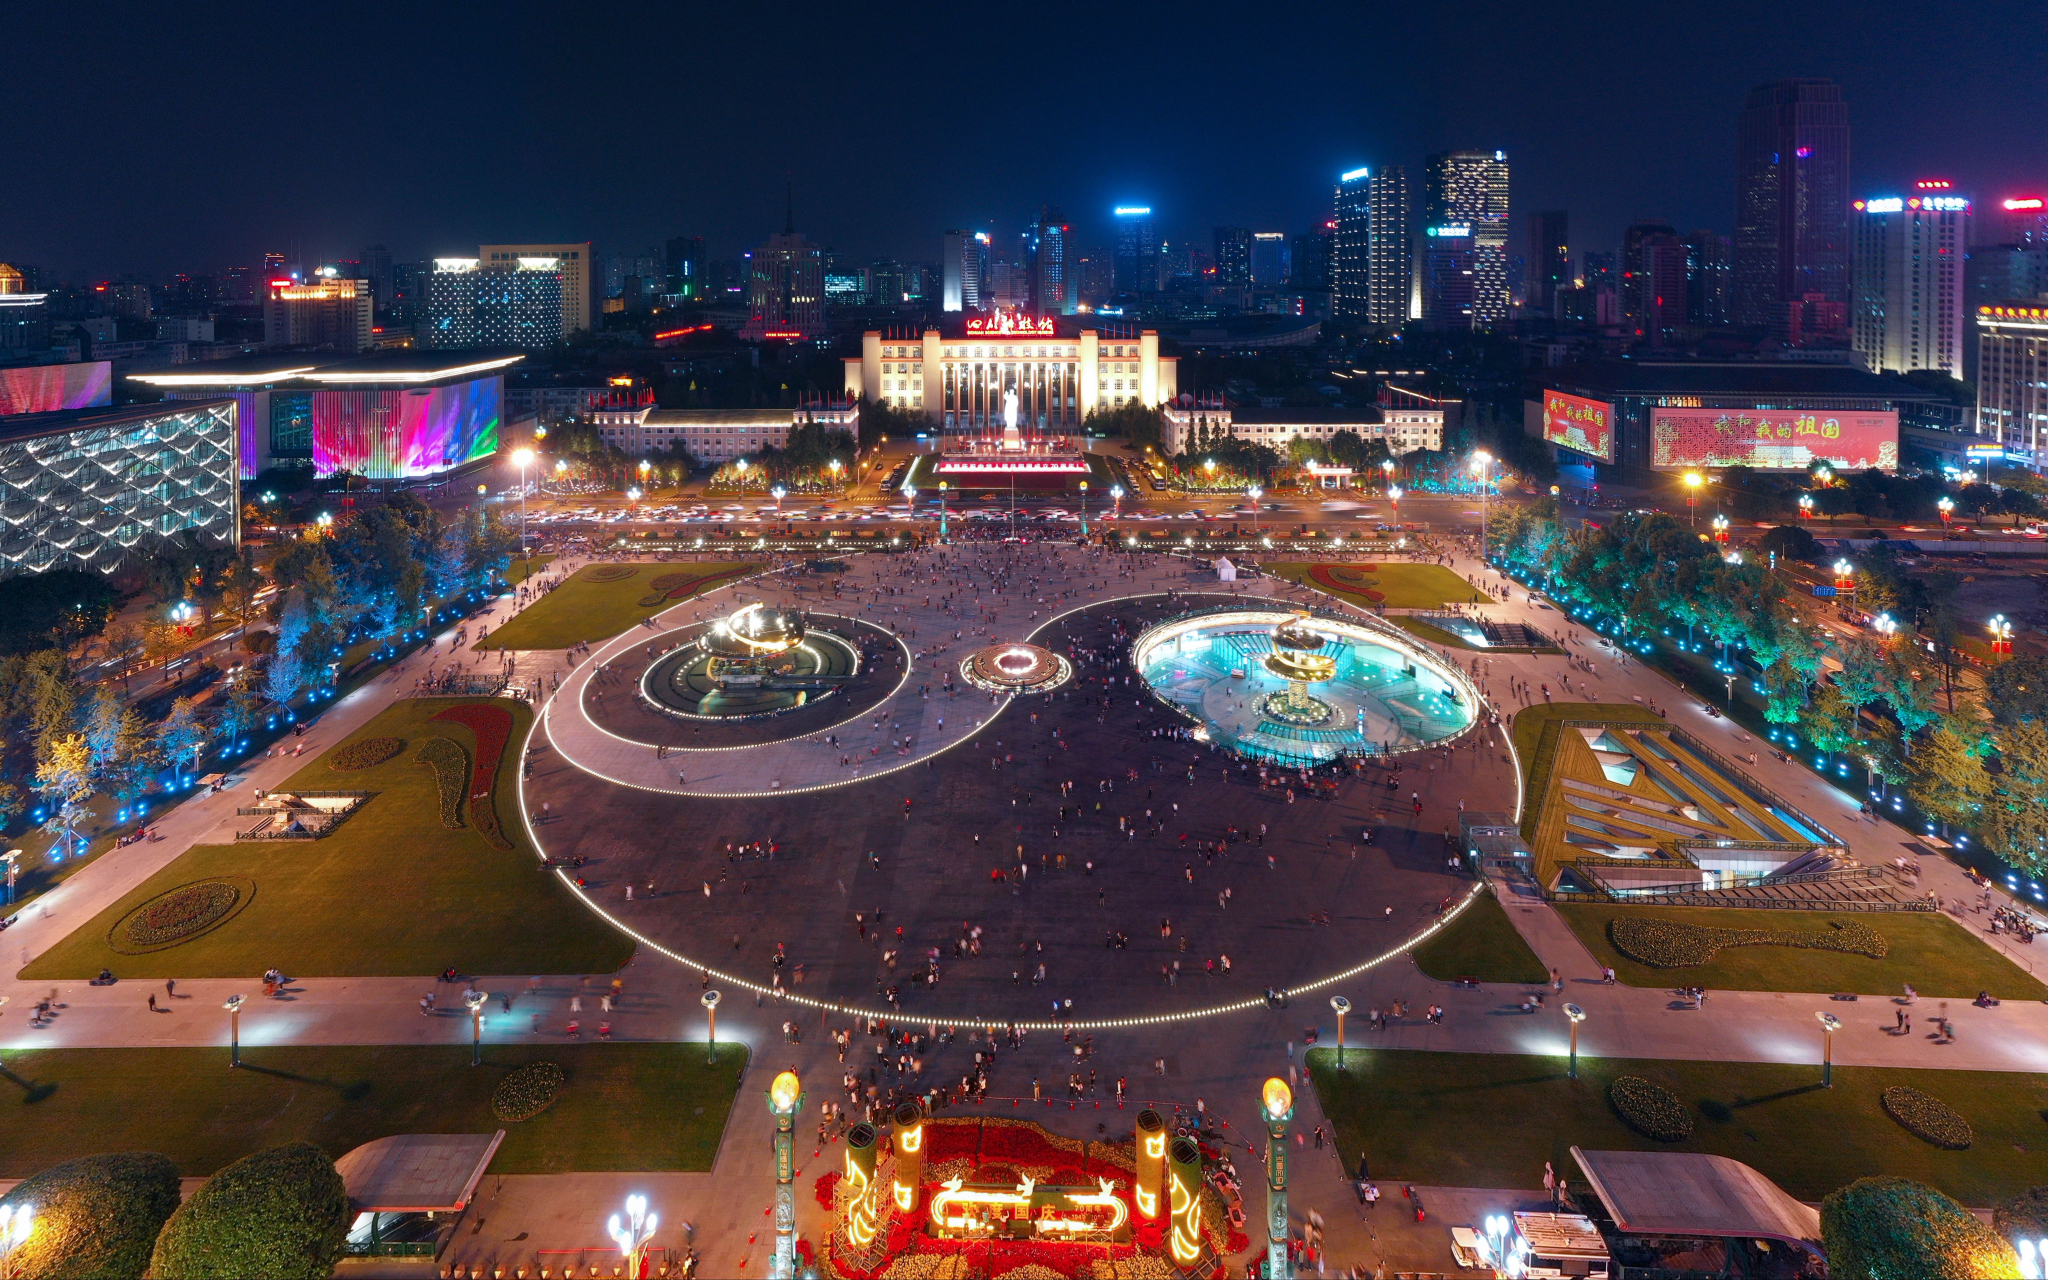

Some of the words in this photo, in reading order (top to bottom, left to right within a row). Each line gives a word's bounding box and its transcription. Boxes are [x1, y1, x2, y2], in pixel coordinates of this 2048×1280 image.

[1714, 413, 1840, 439] 我和我的祖国
[962, 1202, 1056, 1220] 欢度国庆
